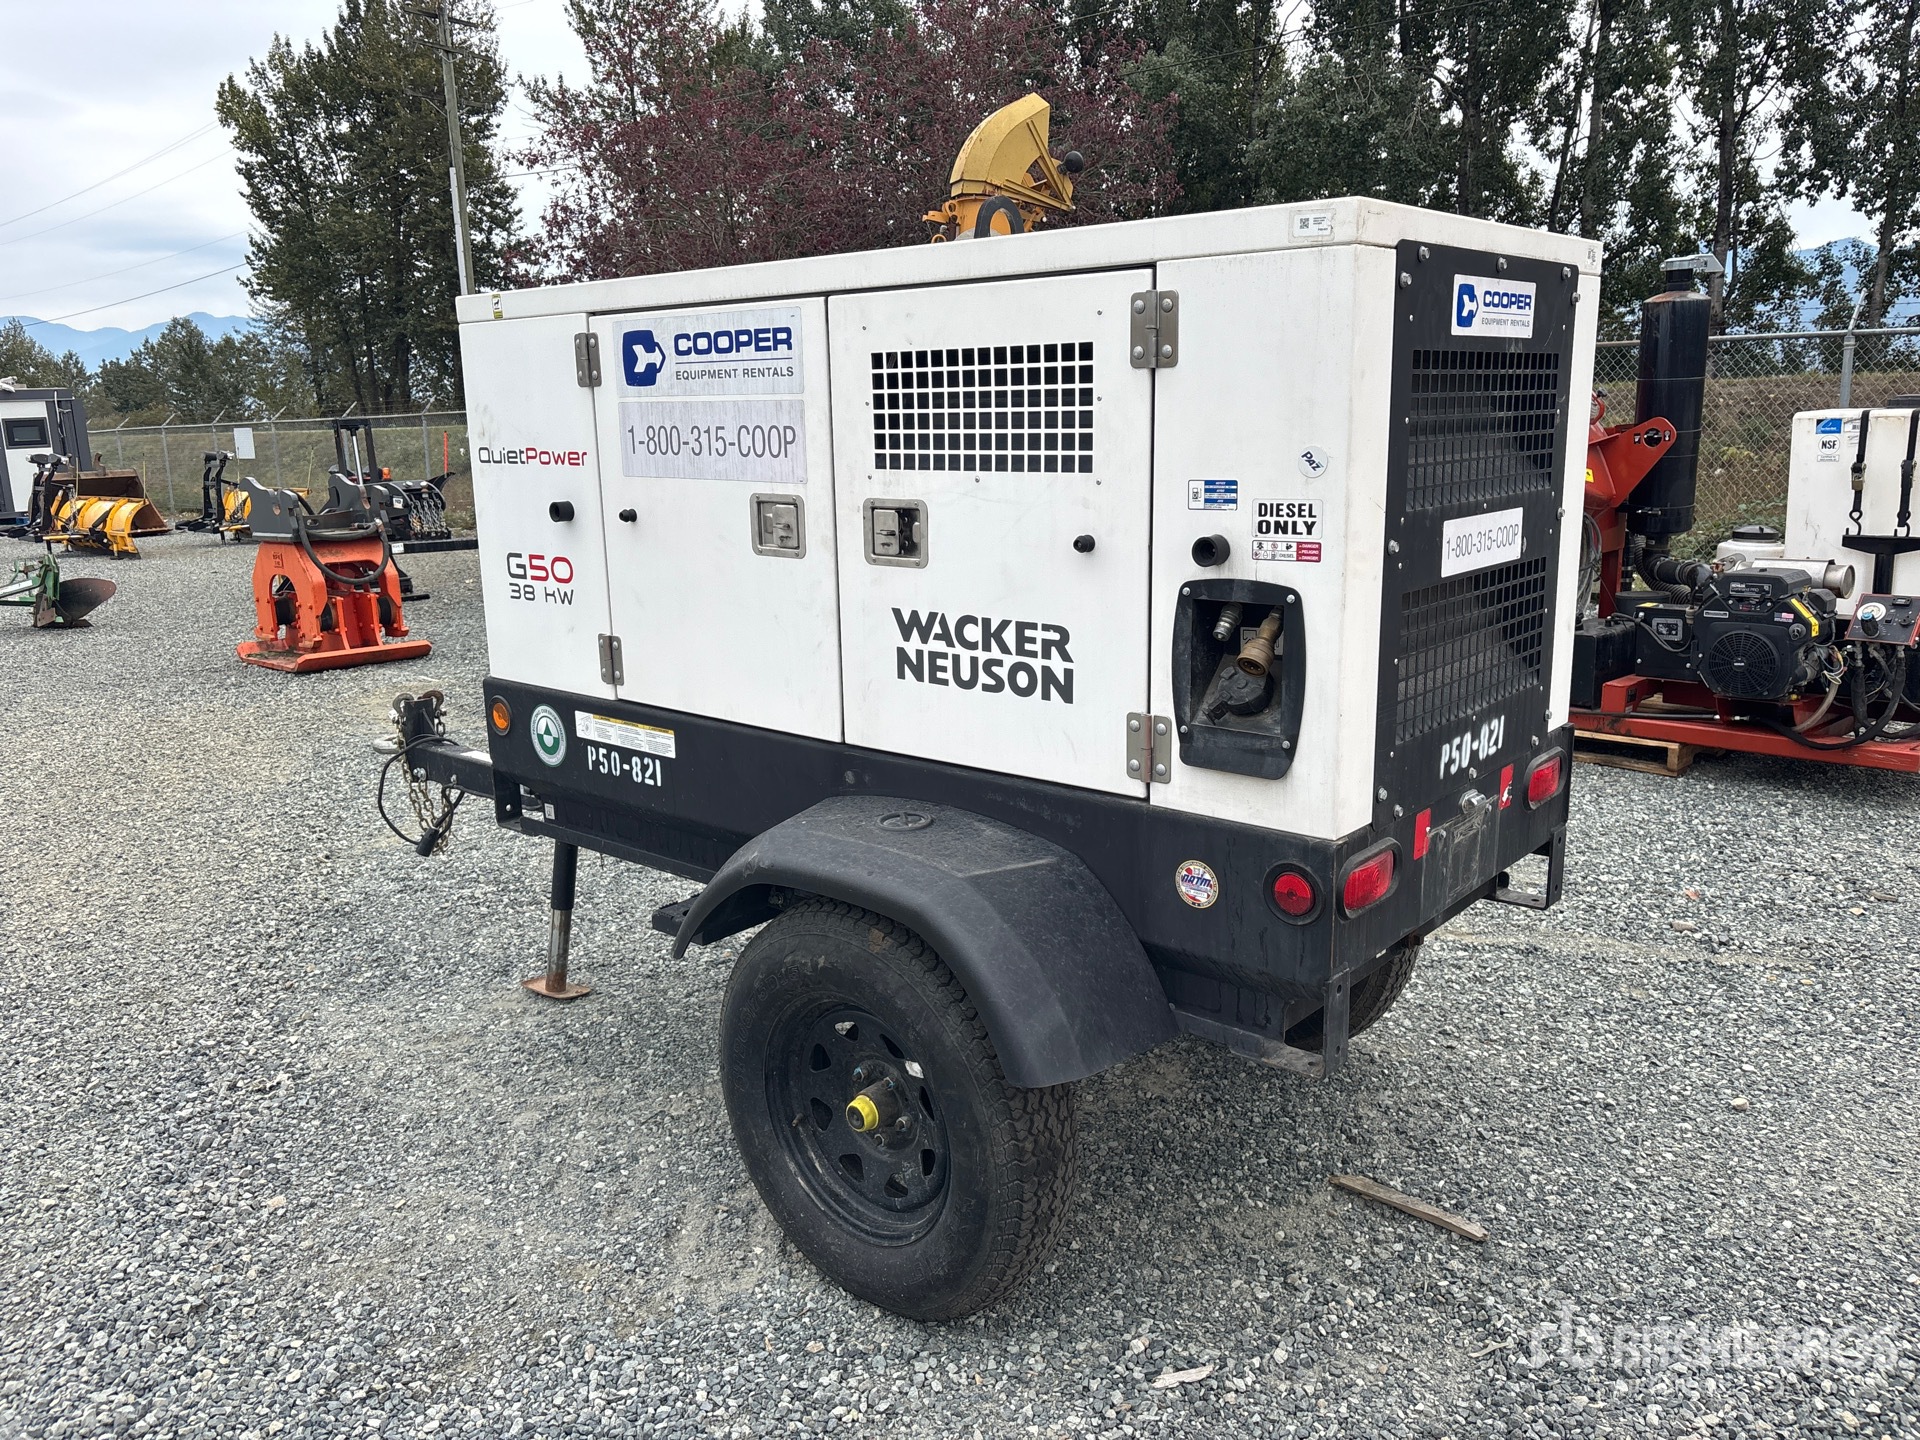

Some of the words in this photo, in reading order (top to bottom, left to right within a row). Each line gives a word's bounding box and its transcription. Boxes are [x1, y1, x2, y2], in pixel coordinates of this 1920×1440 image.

[1483, 290, 1532, 310] COOPER
[1481, 317, 1509, 326] EQUIPMENT
[1510, 319, 1530, 328] RENTALS
[673, 326, 793, 357] COOPER
[675, 368, 739, 381] EQUIPMENT
[742, 366, 795, 379] RENTALS
[627, 424, 797, 460] 1-800-315-COOP
[1821, 440, 1837, 450] NSF
[478, 446, 588, 467] QuietPower
[1300, 450, 1322, 472] PAZ
[1257, 502, 1317, 519] DIESEL
[1257, 519, 1317, 536] ONLY
[1446, 523, 1520, 560] 1-800-315-COOP
[506, 552, 574, 584] G50
[508, 582, 536, 601] 38
[544, 586, 574, 605] kW
[891, 607, 1075, 664] WACKER
[896, 646, 1075, 705] NEUSON
[1439, 714, 1505, 780] P50-821
[587, 745, 662, 787] P50-821
